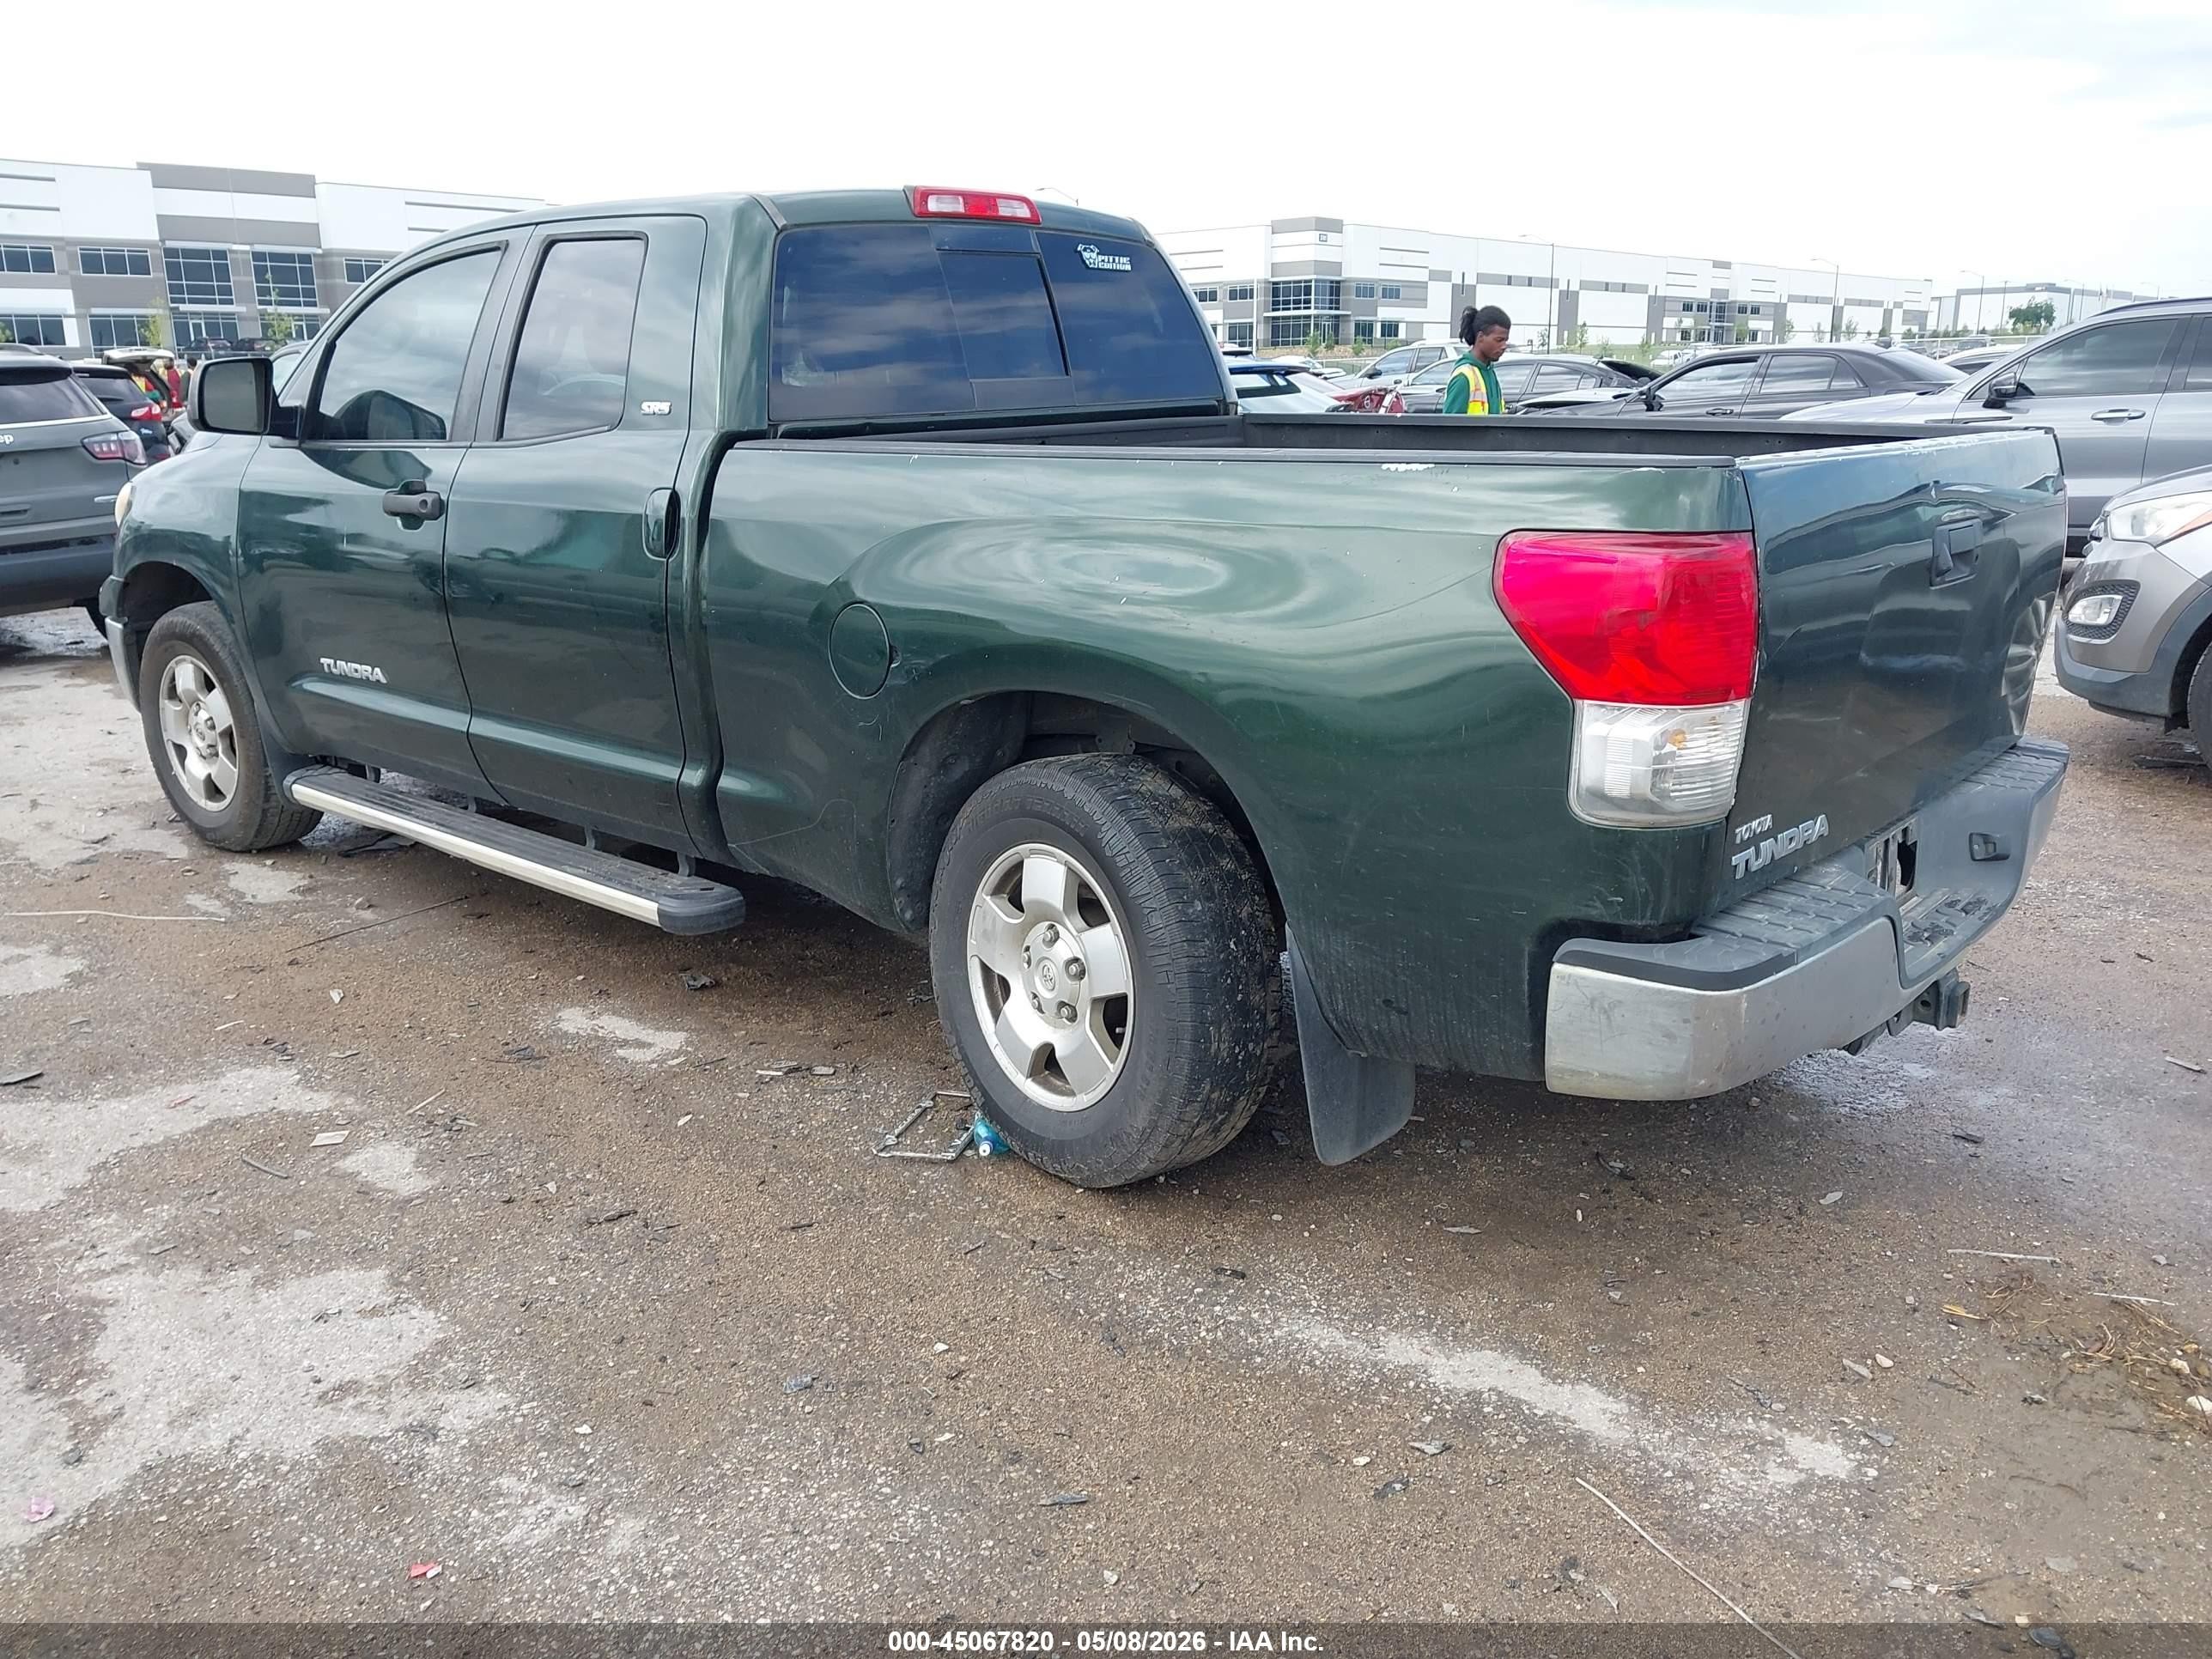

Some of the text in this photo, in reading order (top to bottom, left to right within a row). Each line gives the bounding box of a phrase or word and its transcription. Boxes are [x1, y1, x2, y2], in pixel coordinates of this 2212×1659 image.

[319, 657, 387, 684] TUNDRA
[1735, 813, 1773, 844] TOYOTA
[1731, 813, 1829, 879] TUNDRA
